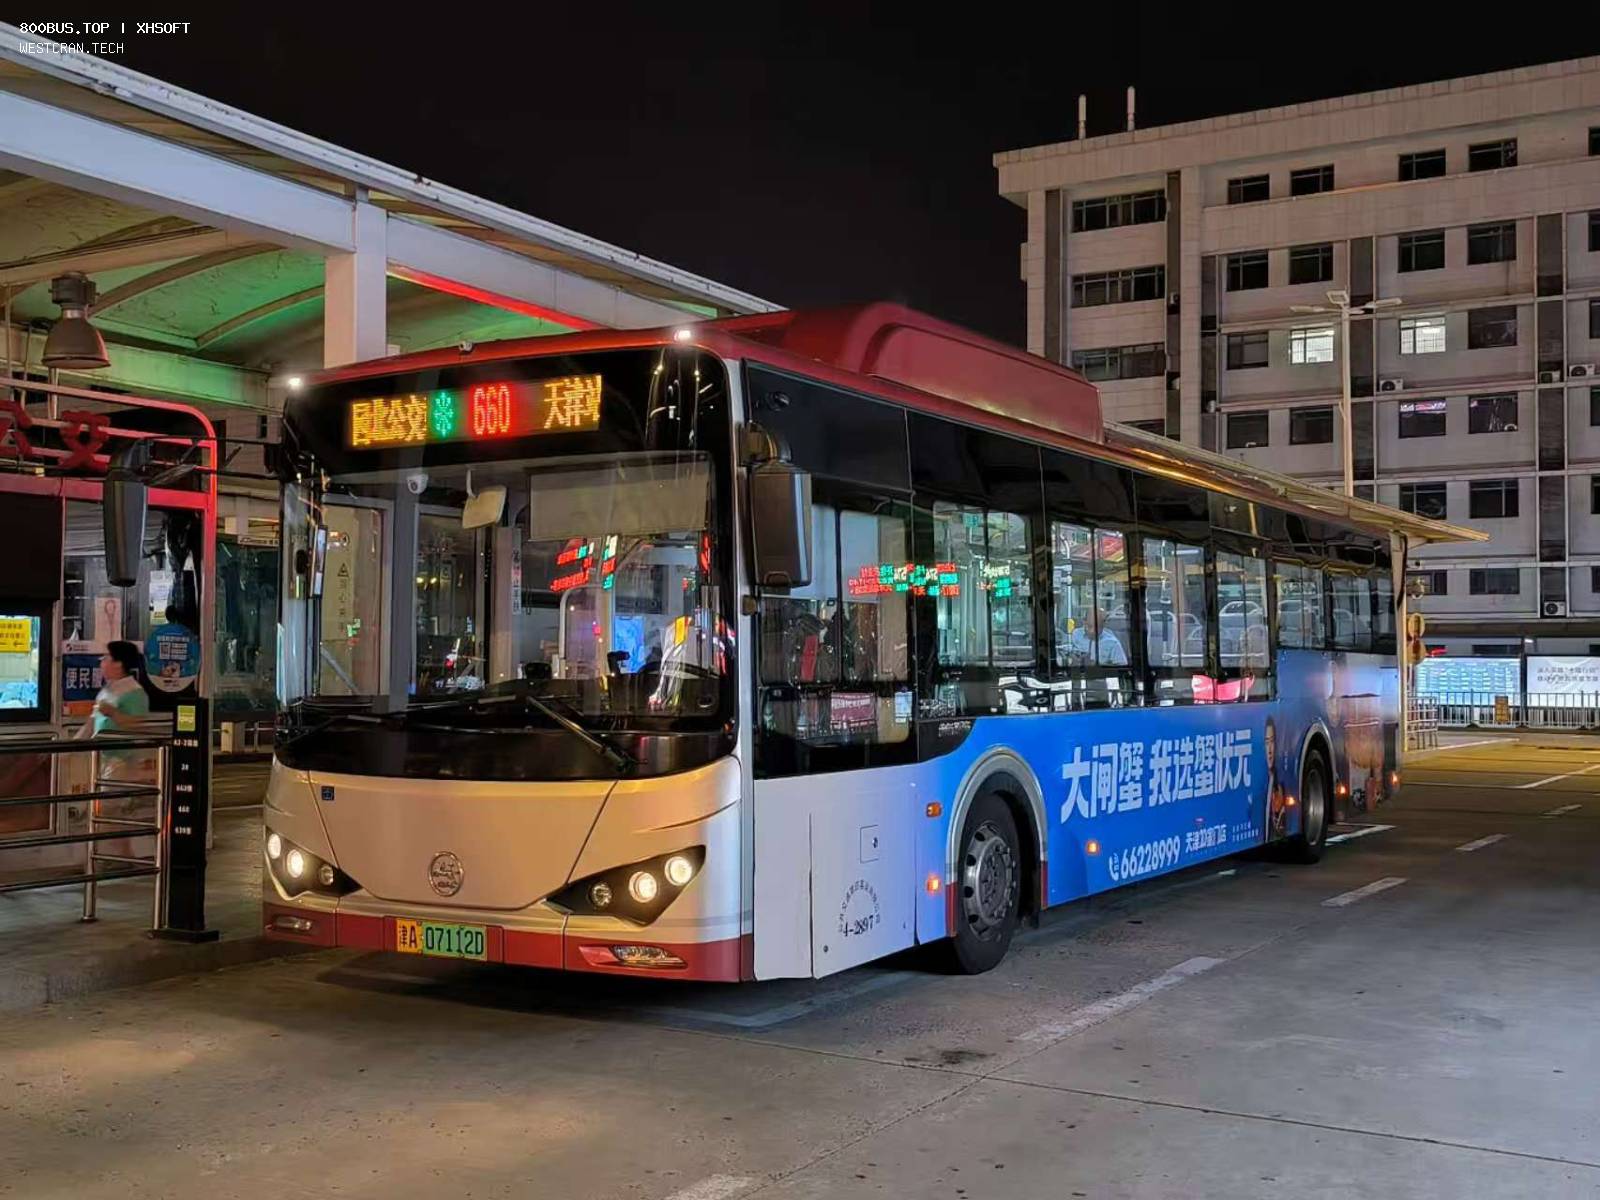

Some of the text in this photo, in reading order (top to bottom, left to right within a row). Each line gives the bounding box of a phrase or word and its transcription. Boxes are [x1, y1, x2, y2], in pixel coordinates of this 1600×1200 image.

[473, 385, 511, 436] 660
[1060, 728, 1252, 825] 大闸蟹 我选蟹状元
[1120, 834, 1181, 880] 66228999
